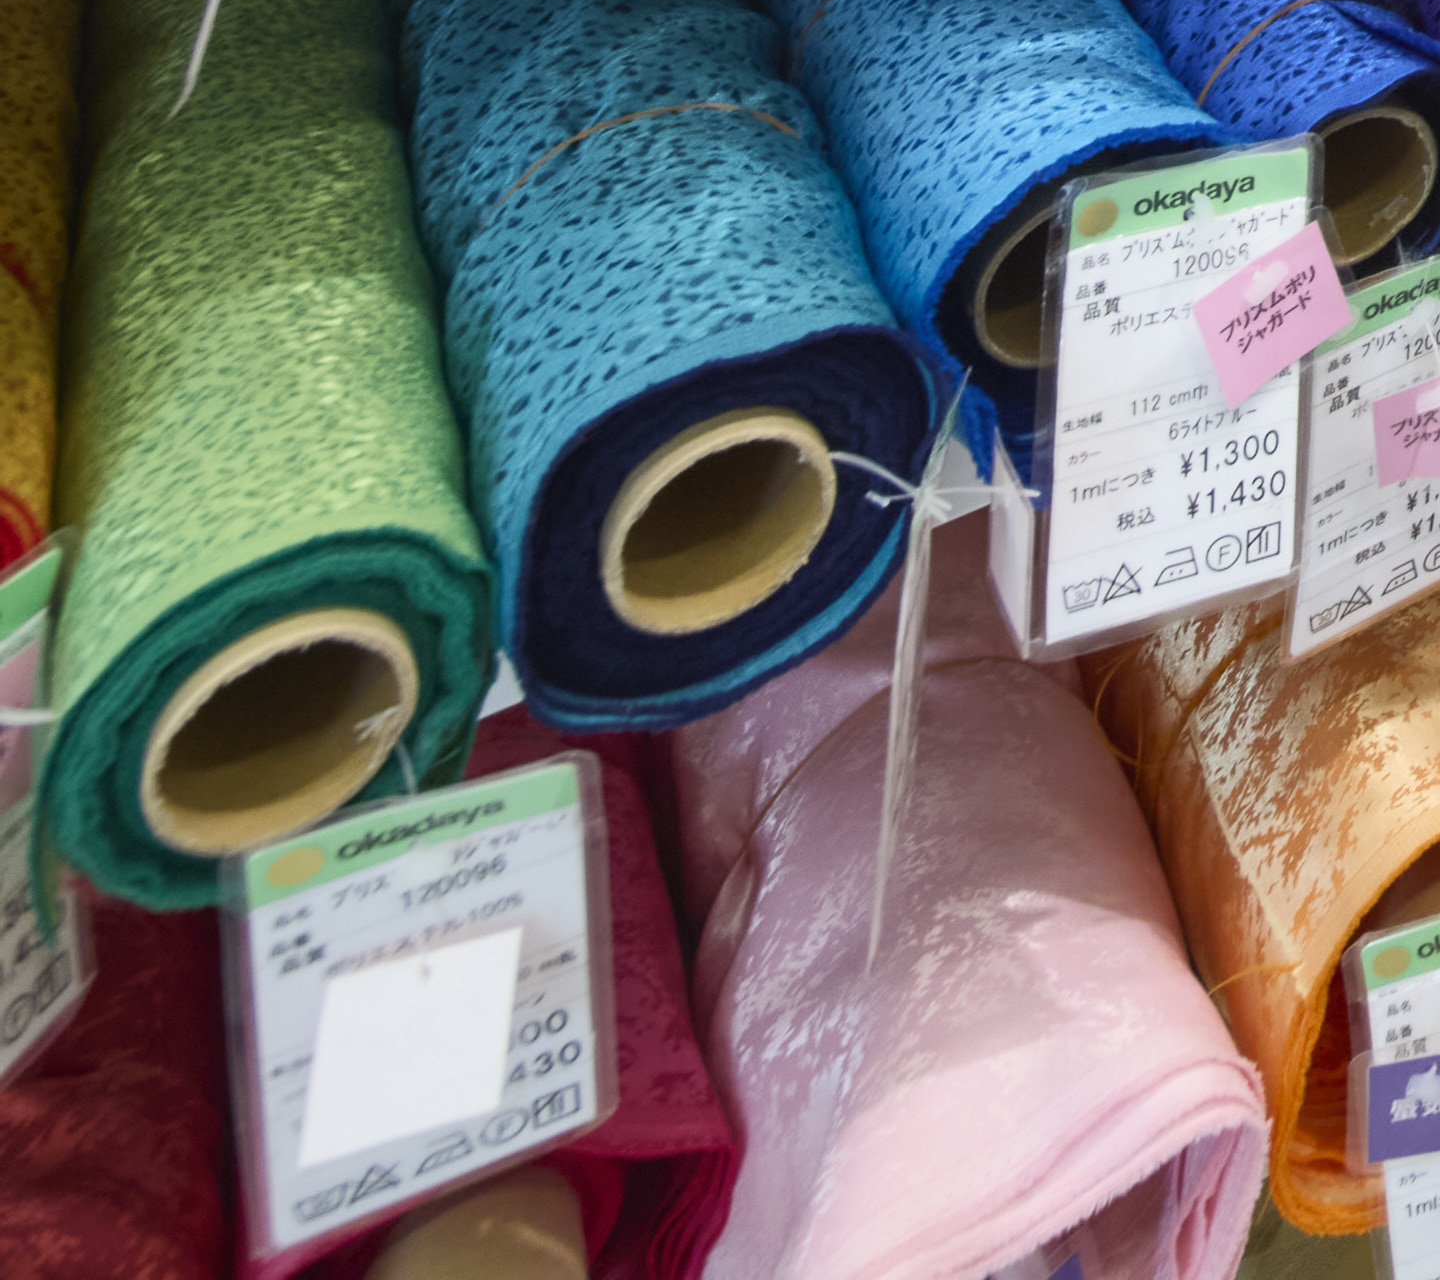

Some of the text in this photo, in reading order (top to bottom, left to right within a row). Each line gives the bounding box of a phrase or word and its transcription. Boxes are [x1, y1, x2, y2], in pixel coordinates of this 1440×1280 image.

[1219, 264, 1317, 344] プリズムポリ
[1236, 293, 1313, 354] ジャガード
[1168, 406, 1258, 441] 6ライトブルー
[1179, 429, 1280, 478] ¥1,300
[1186, 469, 1287, 519] ¥1,430
